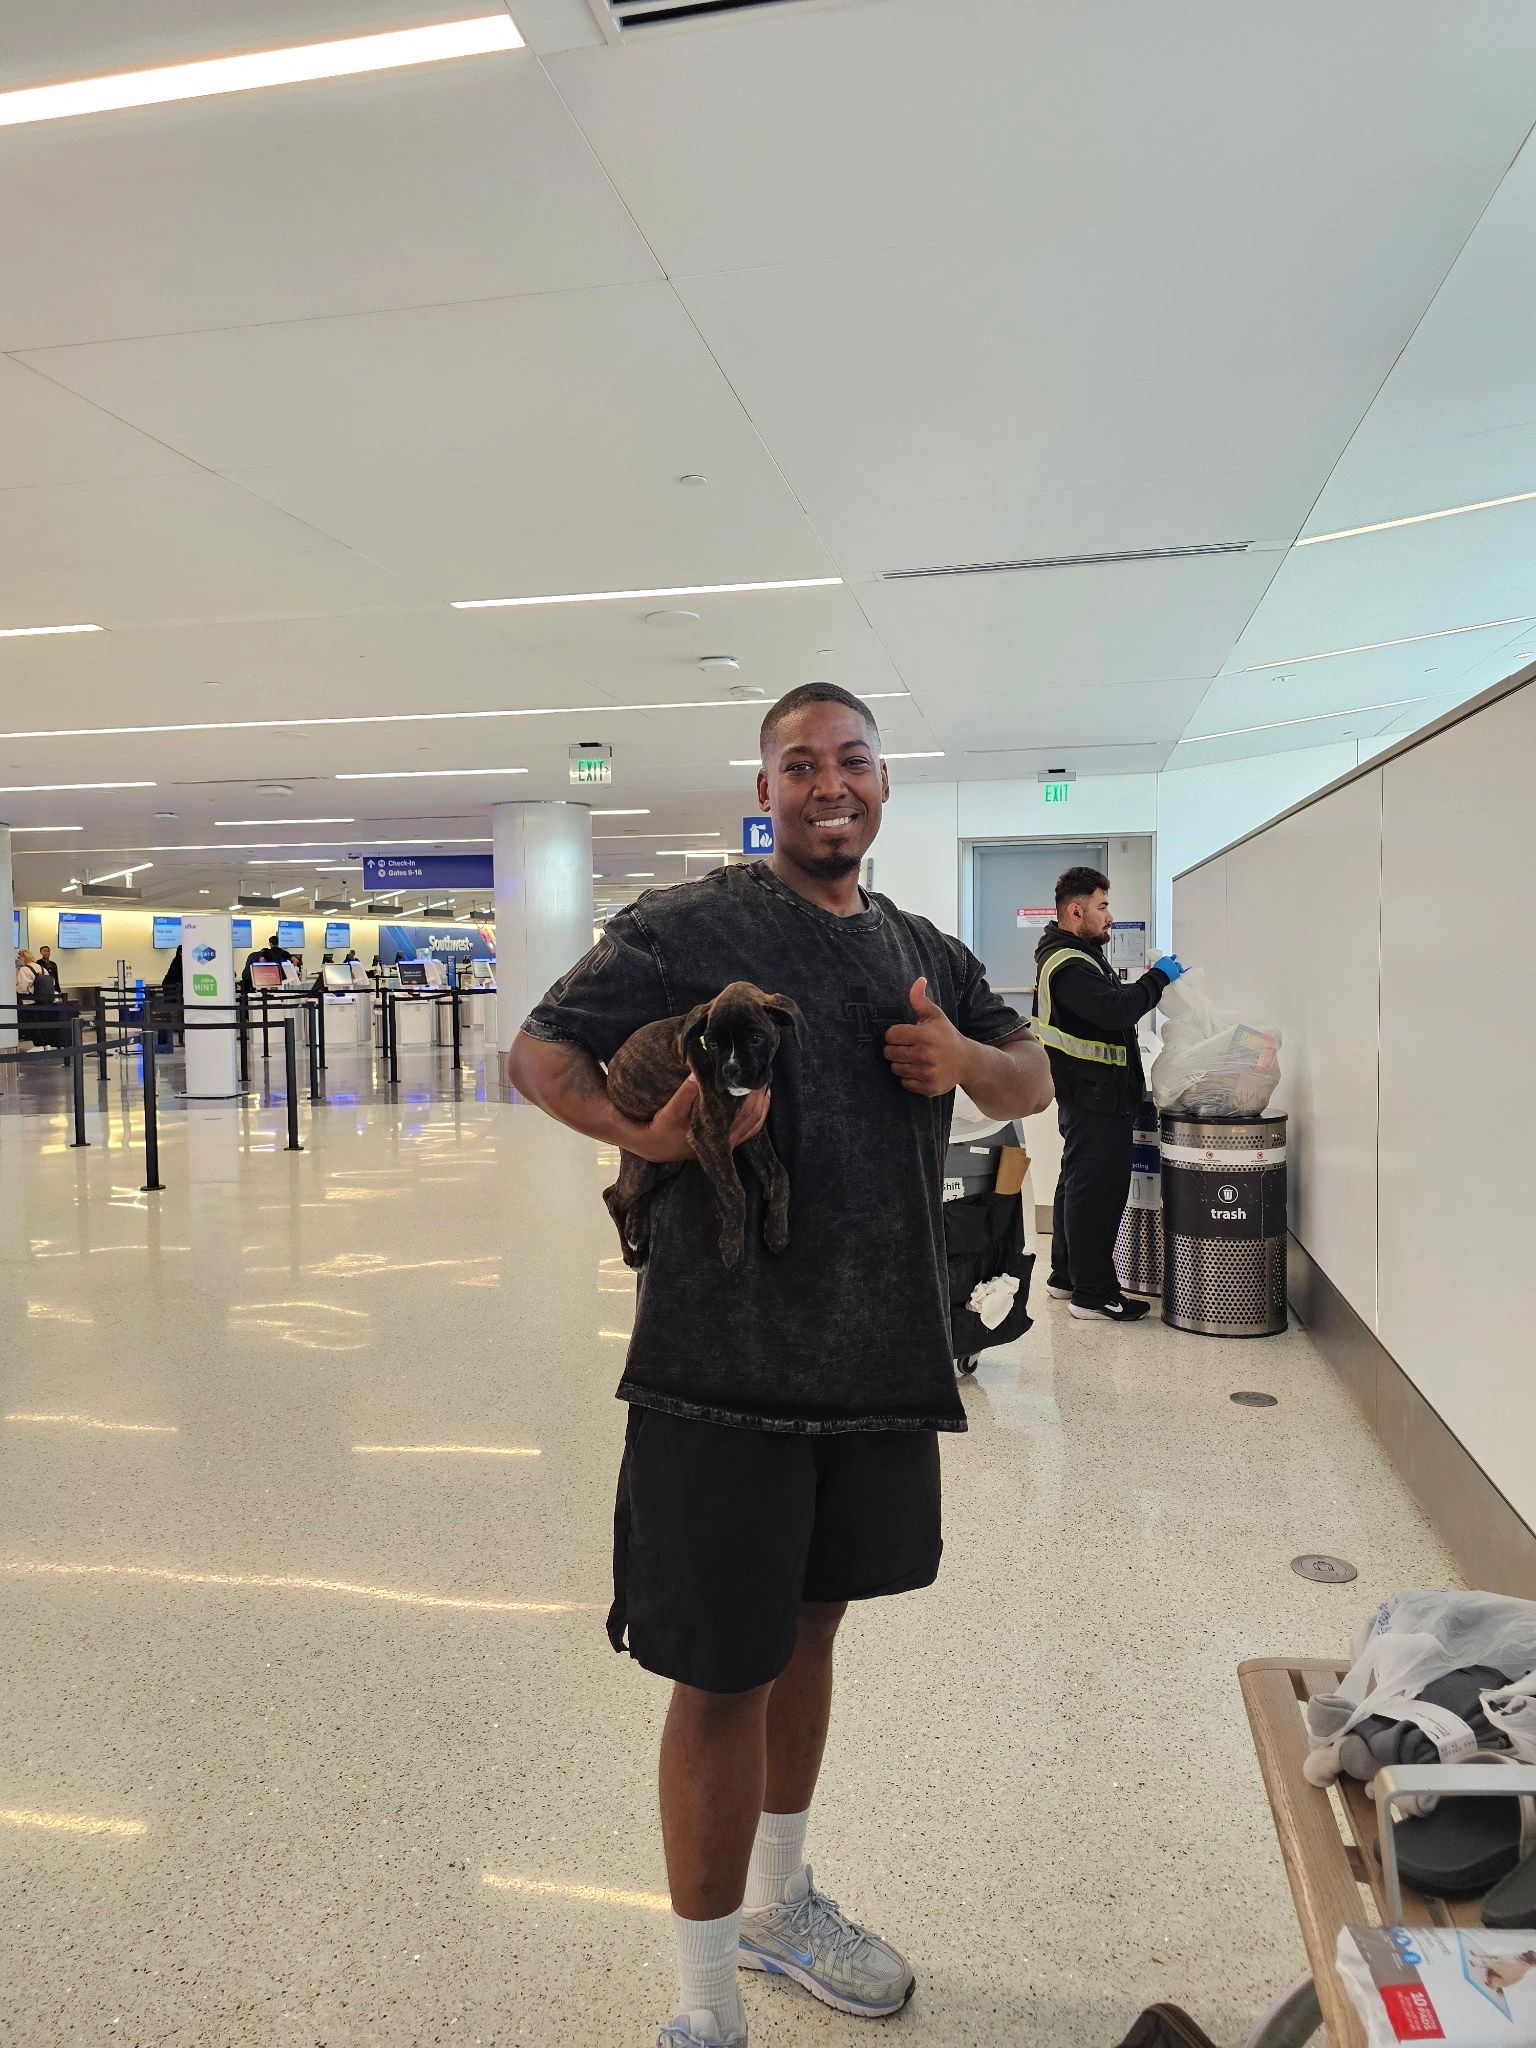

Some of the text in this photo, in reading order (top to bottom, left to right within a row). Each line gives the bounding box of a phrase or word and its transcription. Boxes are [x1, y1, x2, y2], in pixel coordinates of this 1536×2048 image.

[578, 760, 605, 782] EXIT
[1045, 783, 1069, 802] EXIT
[388, 869, 407, 877] Gates
[429, 934, 470, 952] Southwest
[194, 983, 216, 992] MINT
[1132, 1162, 1149, 1170] ycling
[1210, 1208, 1247, 1220] trash
[1410, 1991, 1427, 2007] 10
